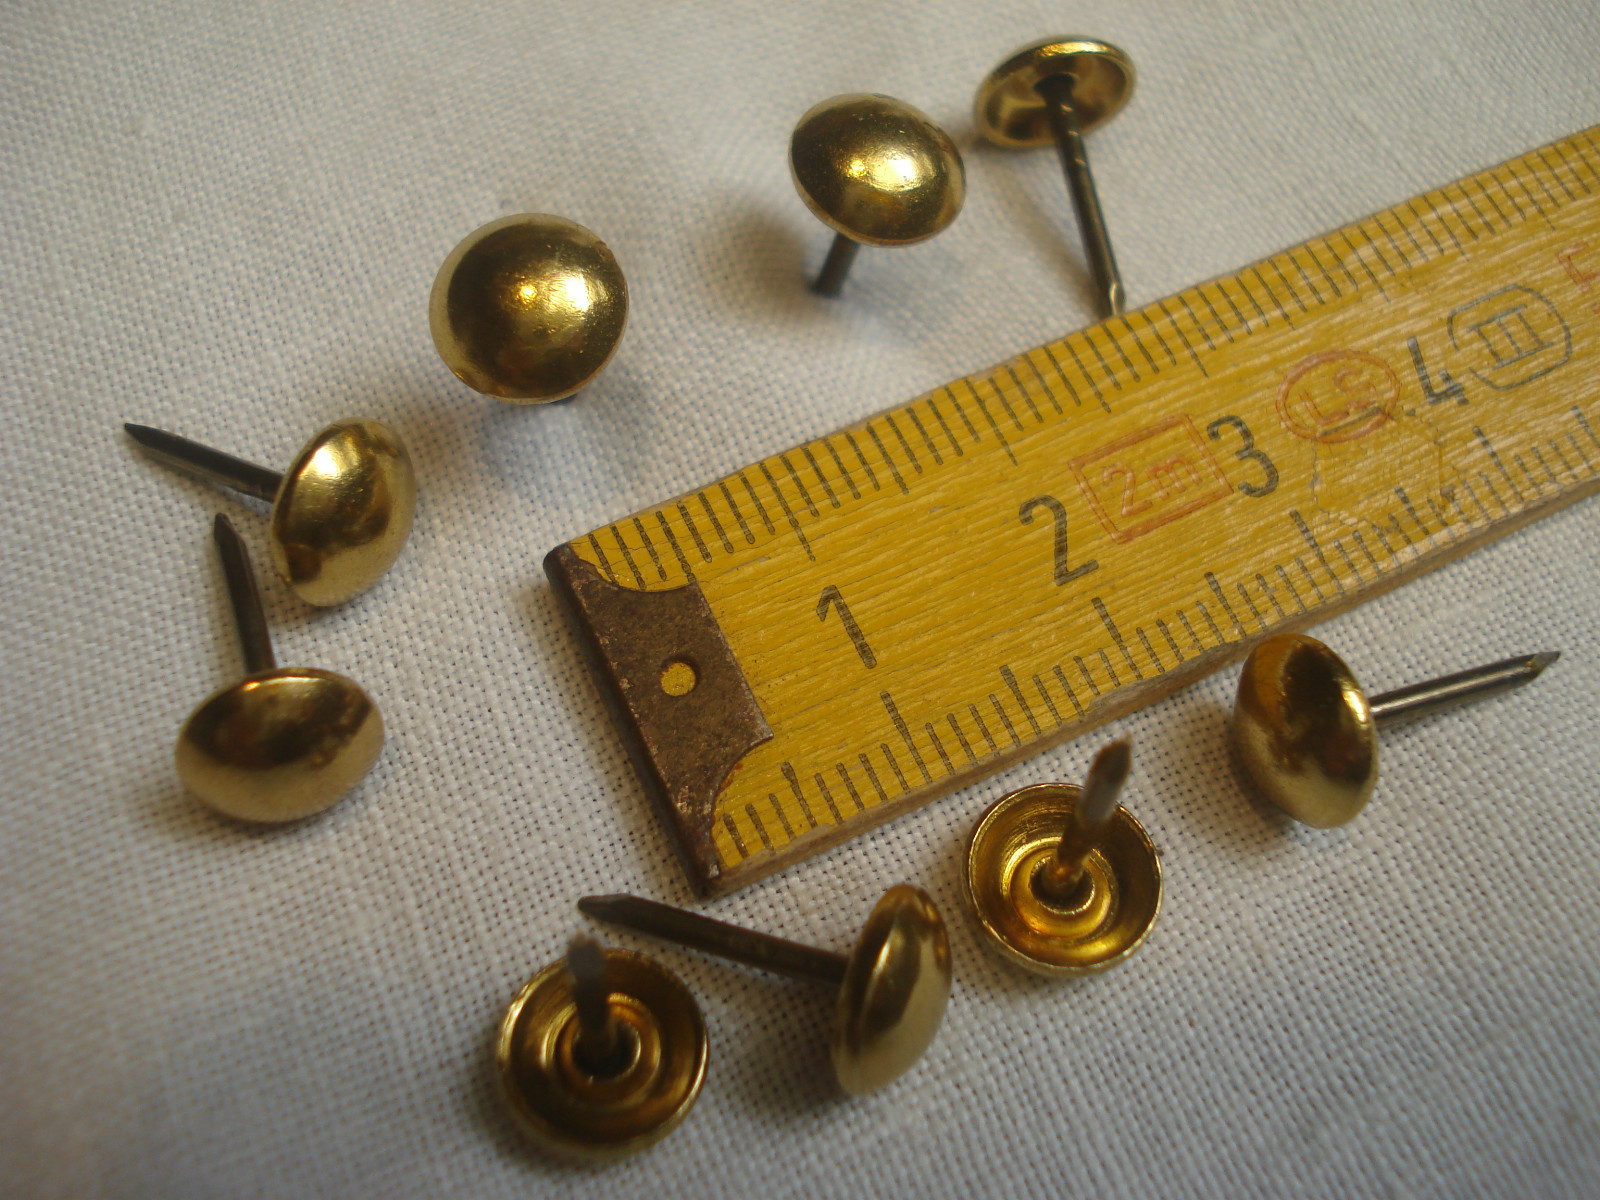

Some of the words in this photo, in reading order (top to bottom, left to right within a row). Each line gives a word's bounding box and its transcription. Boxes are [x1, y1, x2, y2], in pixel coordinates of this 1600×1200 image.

[816, 585, 877, 668] 1
[1019, 495, 1099, 586] 2
[1206, 415, 1279, 497] 3
[1407, 336, 1470, 405] 4
[1102, 455, 1204, 517] 2m
